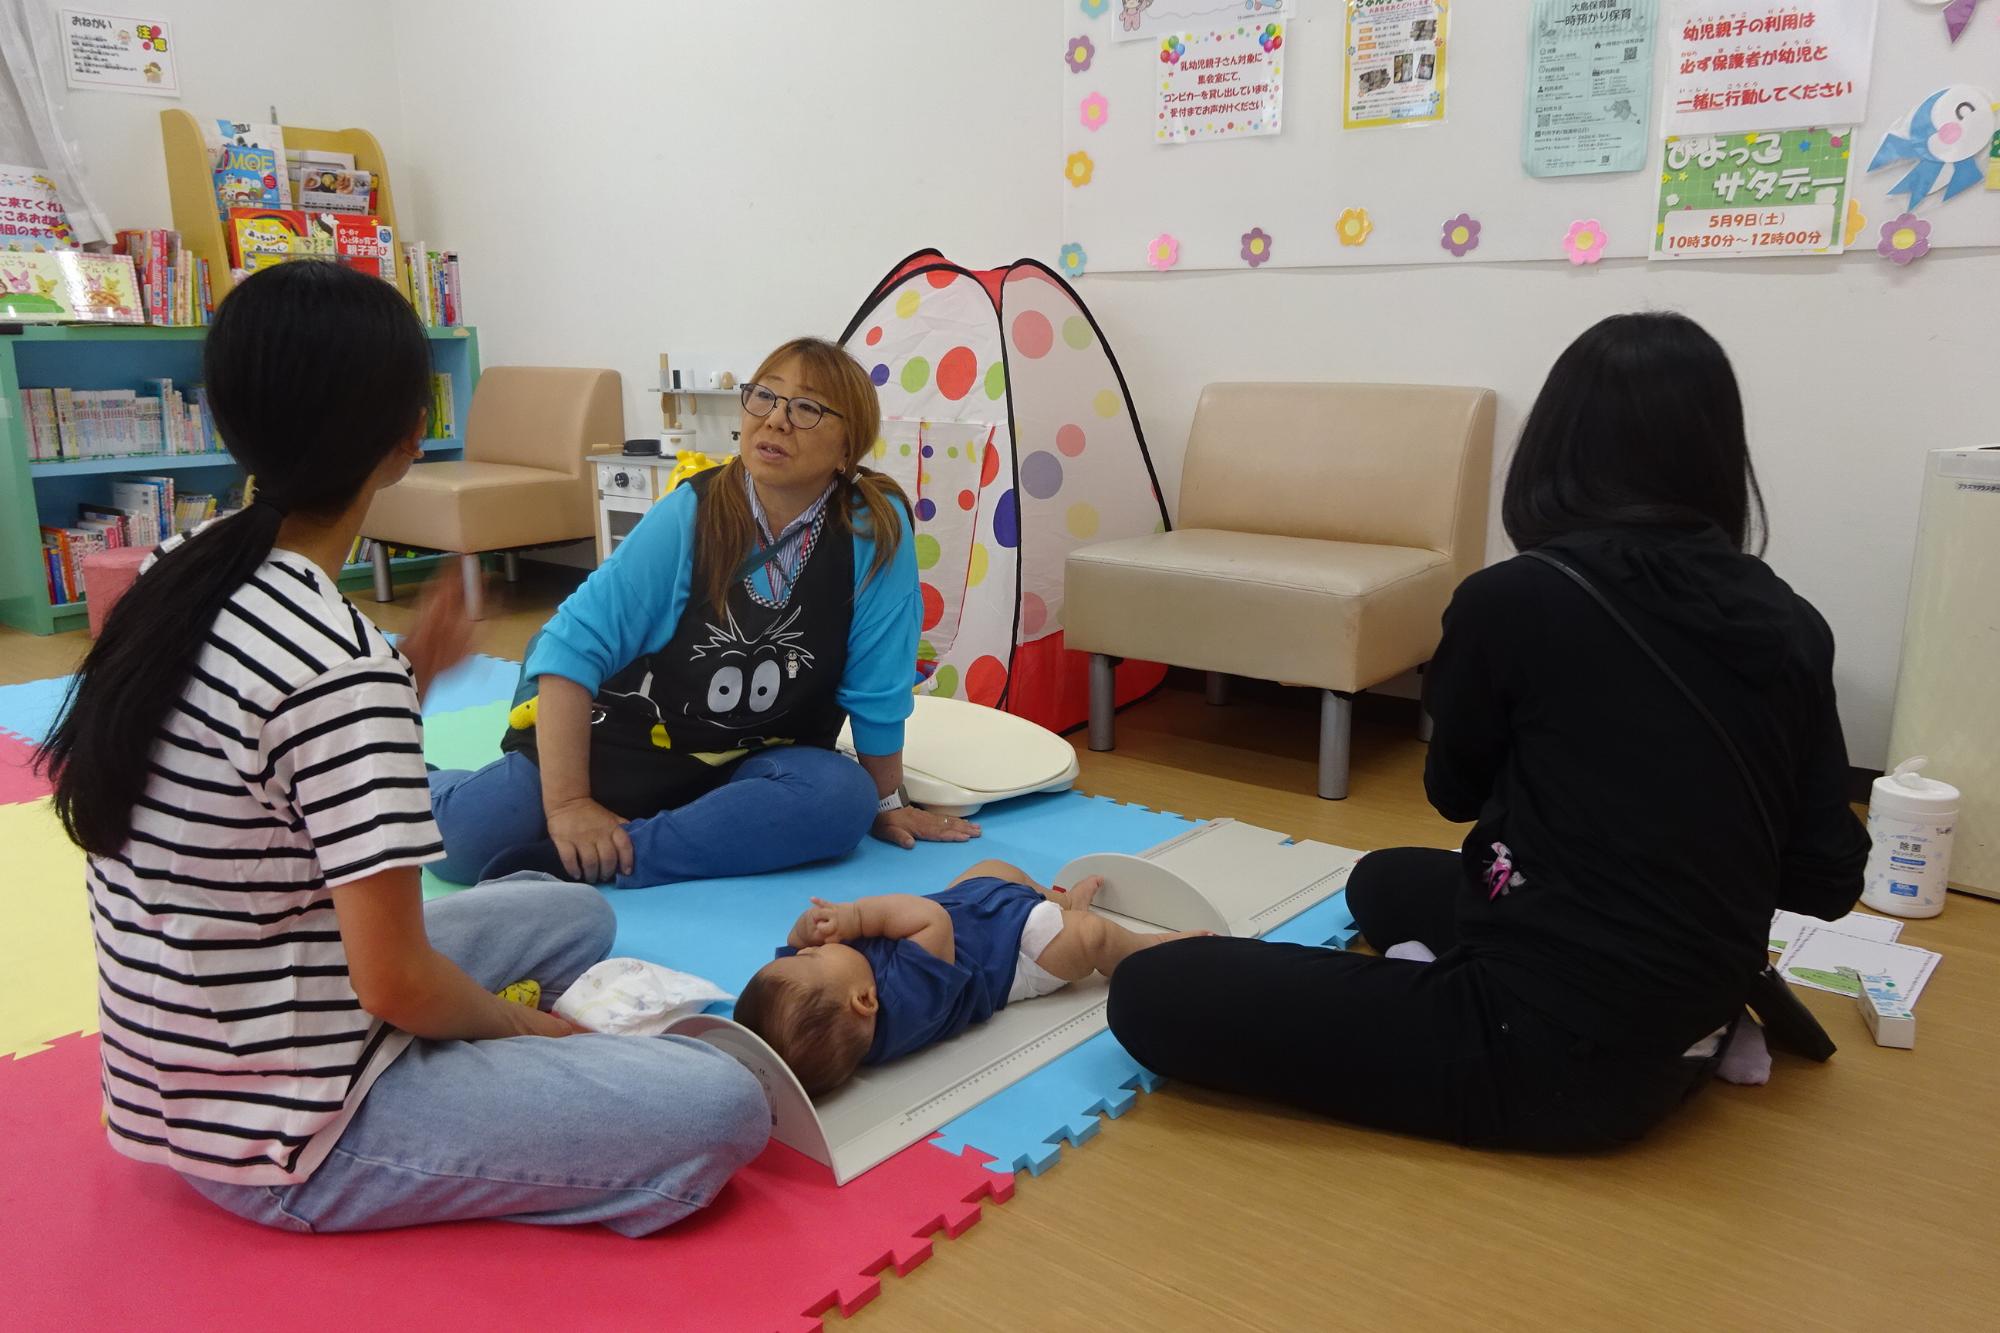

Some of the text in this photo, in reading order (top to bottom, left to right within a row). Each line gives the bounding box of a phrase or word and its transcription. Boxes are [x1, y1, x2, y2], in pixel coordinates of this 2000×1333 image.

[1554, 9, 1632, 27] 一時預かり保育
[1683, 12, 1815, 41] 幼児親子の利用は
[1180, 53, 1263, 71] 乳幼児親子さん対象に
[1680, 46, 1828, 74] 必ず保護者が幼児と
[1677, 81, 1853, 110] 一緒に行動してください
[226, 151, 275, 172] MOE
[1713, 167, 1845, 203] サタデー
[1709, 212, 1785, 228] 5月9日(土)
